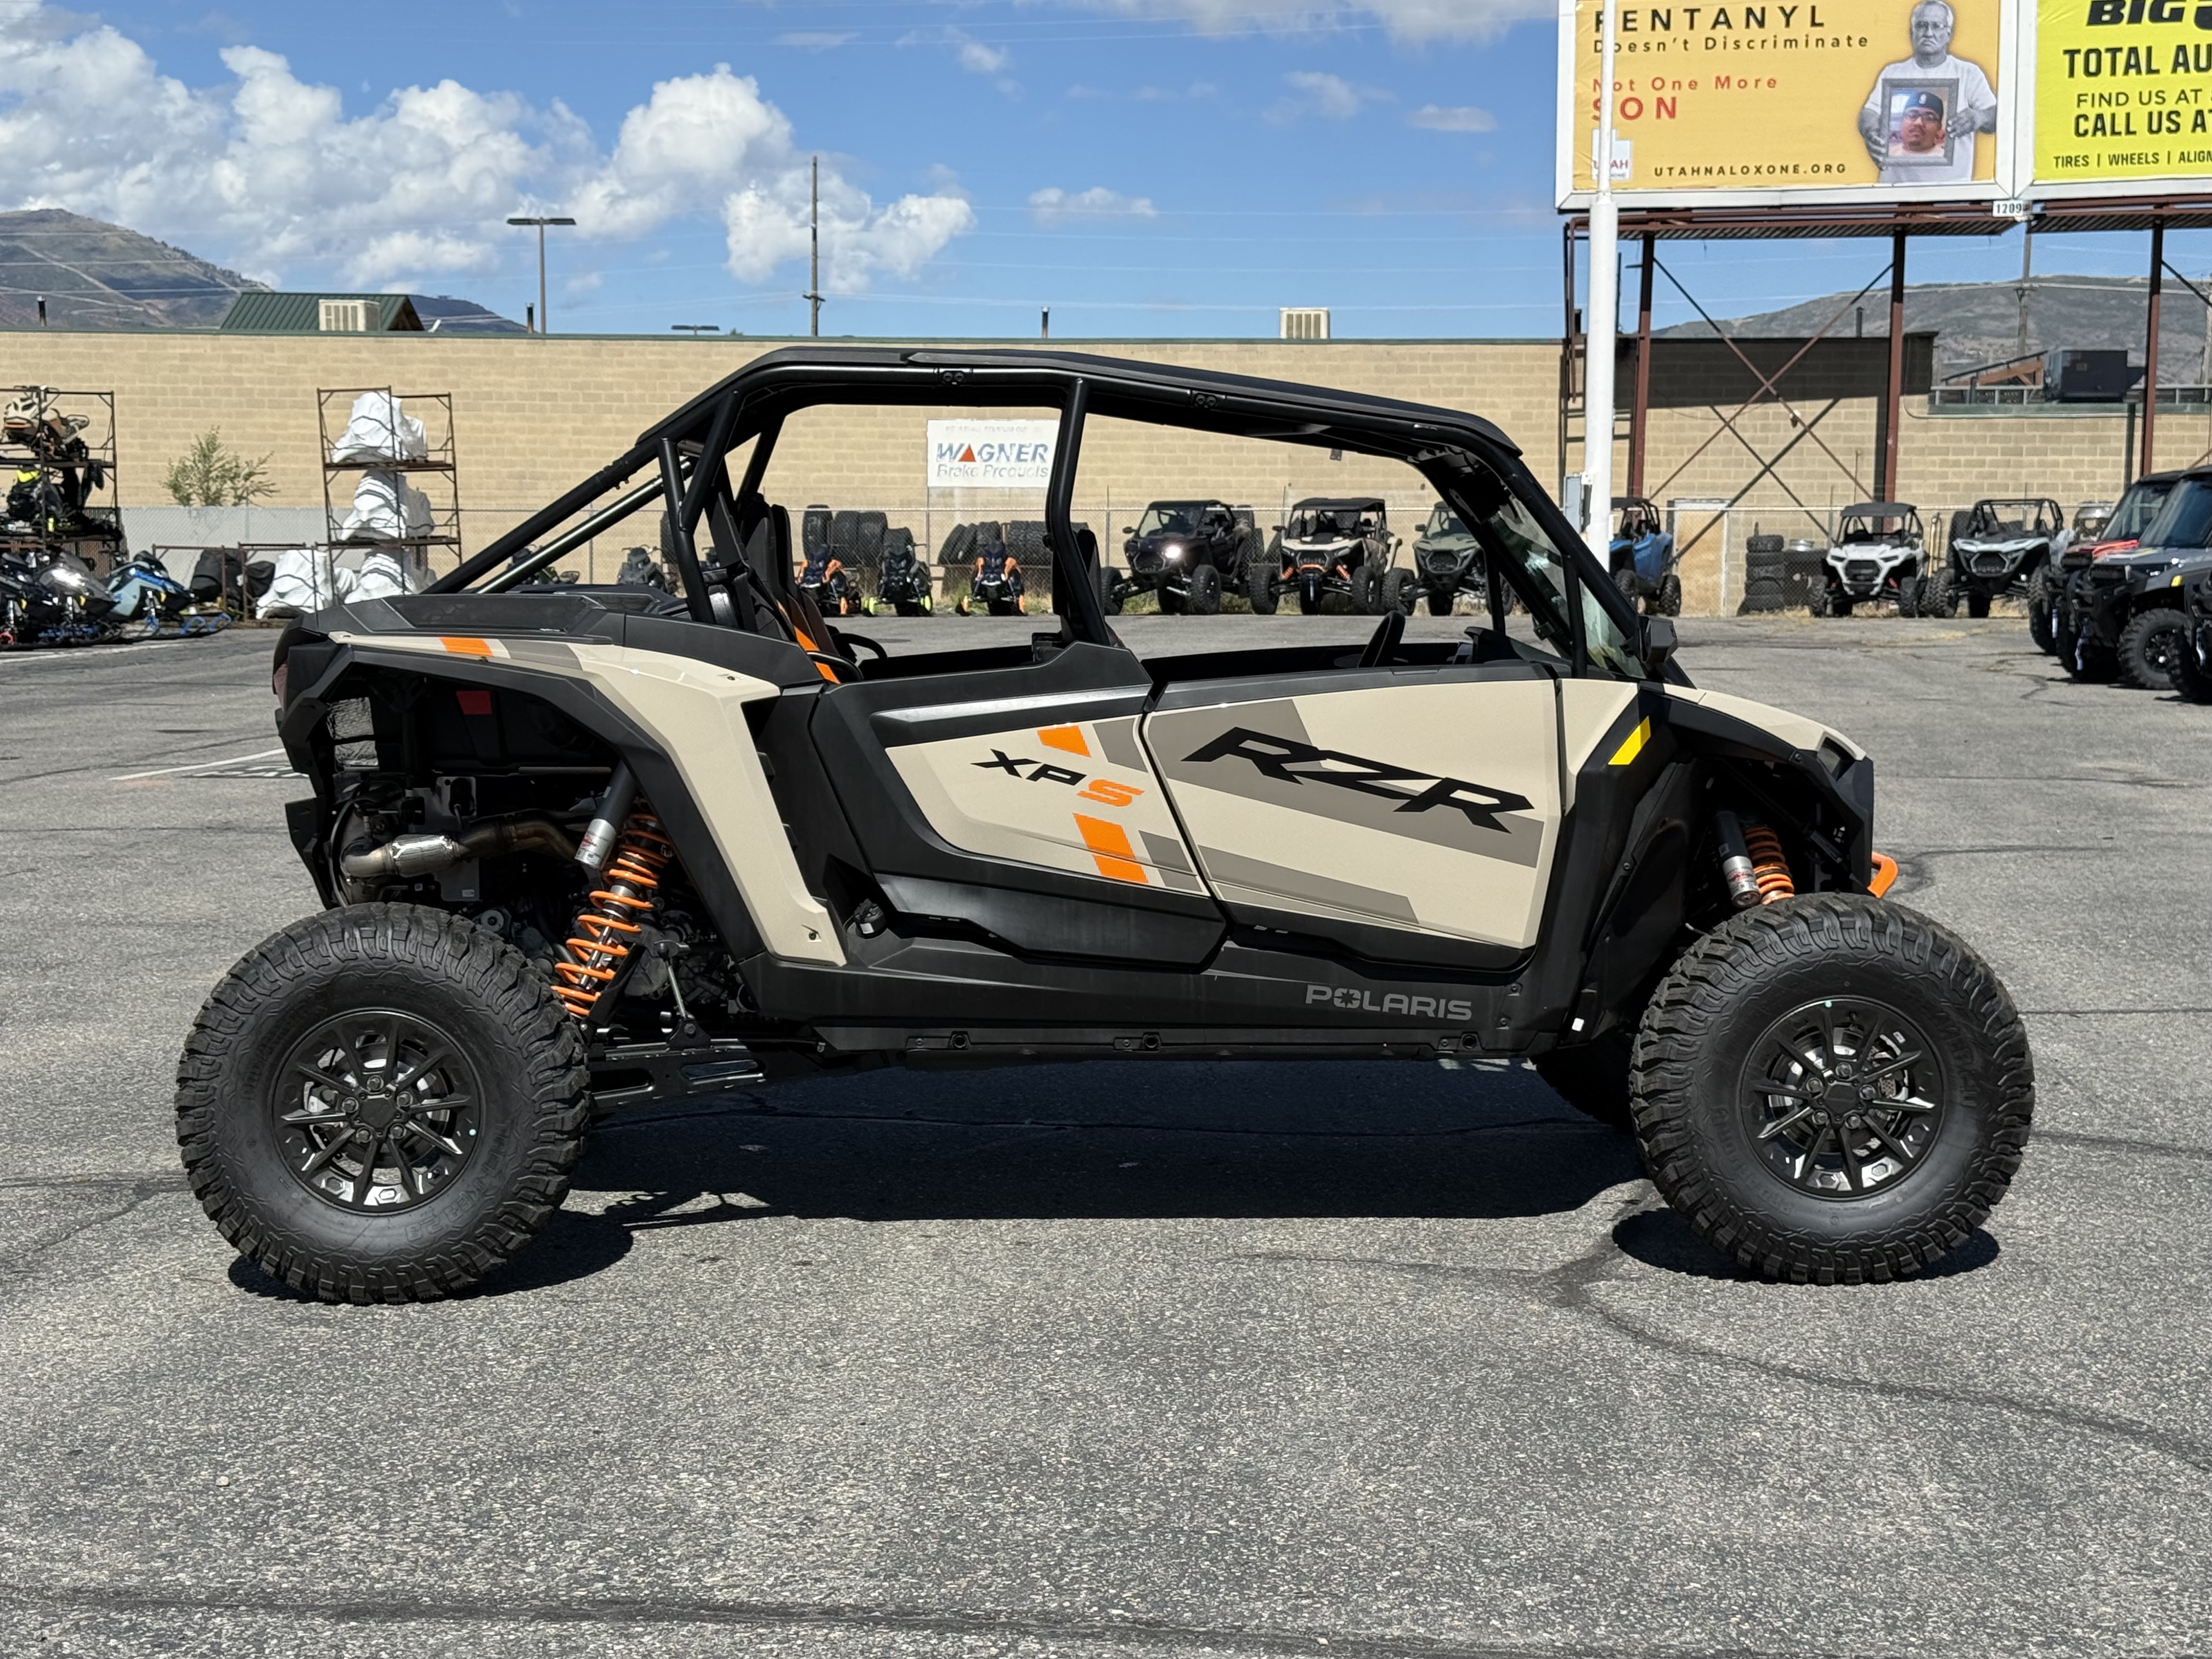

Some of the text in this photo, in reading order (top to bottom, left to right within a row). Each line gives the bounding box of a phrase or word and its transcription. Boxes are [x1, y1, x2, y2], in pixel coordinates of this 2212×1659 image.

[2086, 0, 2185, 26] BIG
[1594, 34, 1869, 53] Doesn't Discriminate
[2063, 46, 2160, 78] TOTAL
[1593, 76, 1778, 93] Not One More
[2076, 92, 2129, 108] FIND
[2140, 90, 2166, 105] US
[2175, 89, 2202, 104] AT
[2074, 112, 2136, 137] CALL
[2147, 110, 2181, 134] US
[1654, 163, 1847, 177] UTAHNALOXONE.ORG
[2053, 155, 2090, 168] TIRES
[2108, 153, 2159, 166] WHEELS
[1997, 203, 2022, 214] 1209
[936, 443, 1049, 462] WAGNER
[970, 748, 1145, 807] XPS
[1181, 727, 1534, 833] RZR
[1305, 985, 1472, 1020] POLARIS
